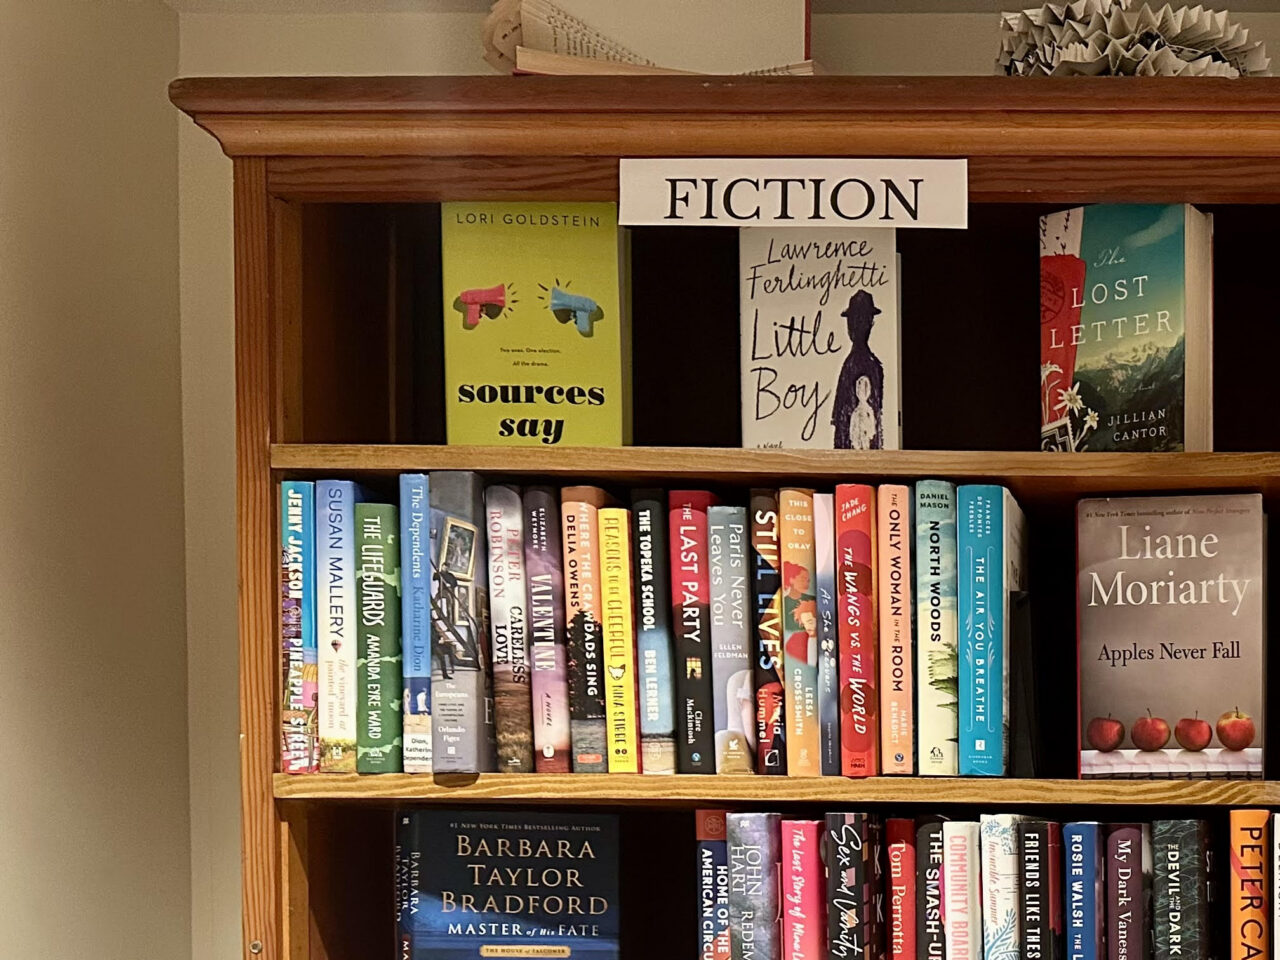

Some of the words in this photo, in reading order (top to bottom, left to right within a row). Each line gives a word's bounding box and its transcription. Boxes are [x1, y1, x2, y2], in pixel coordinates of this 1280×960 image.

[665, 177, 923, 220] FICTION
[456, 213, 493, 224] LORI
[504, 214, 600, 227] GOLDSTEIN
[768, 238, 873, 264] Lawrence
[1094, 247, 1125, 268] The
[746, 260, 888, 305] Ferlinghetti
[1071, 275, 1148, 308] LOST
[752, 308, 841, 361] Little
[1049, 311, 1173, 348] LETTER
[458, 384, 605, 405] sources
[751, 367, 831, 441] Boy
[499, 417, 564, 444] say
[1108, 409, 1166, 426] JILLIAN
[1113, 426, 1166, 441] CANTOR
[328, 488, 342, 549] SUSAN
[930, 521, 941, 576] NORTH
[1118, 525, 1218, 560] Liane
[329, 558, 343, 637] MALLERY
[1088, 570, 1252, 616] Moriarty
[930, 589, 941, 642] WOODS
[1098, 643, 1154, 667] Apples
[1160, 642, 1207, 660] Never
[1212, 641, 1240, 659] Fall
[457, 835, 596, 858] BARBARA
[467, 865, 584, 887] TAYLOR
[1240, 826, 1263, 912] PETER
[441, 891, 608, 914] BRADFORD
[448, 923, 522, 935] MASTER
[527, 928, 536, 937] of
[540, 927, 556, 936] His
[559, 925, 599, 936] FATE
